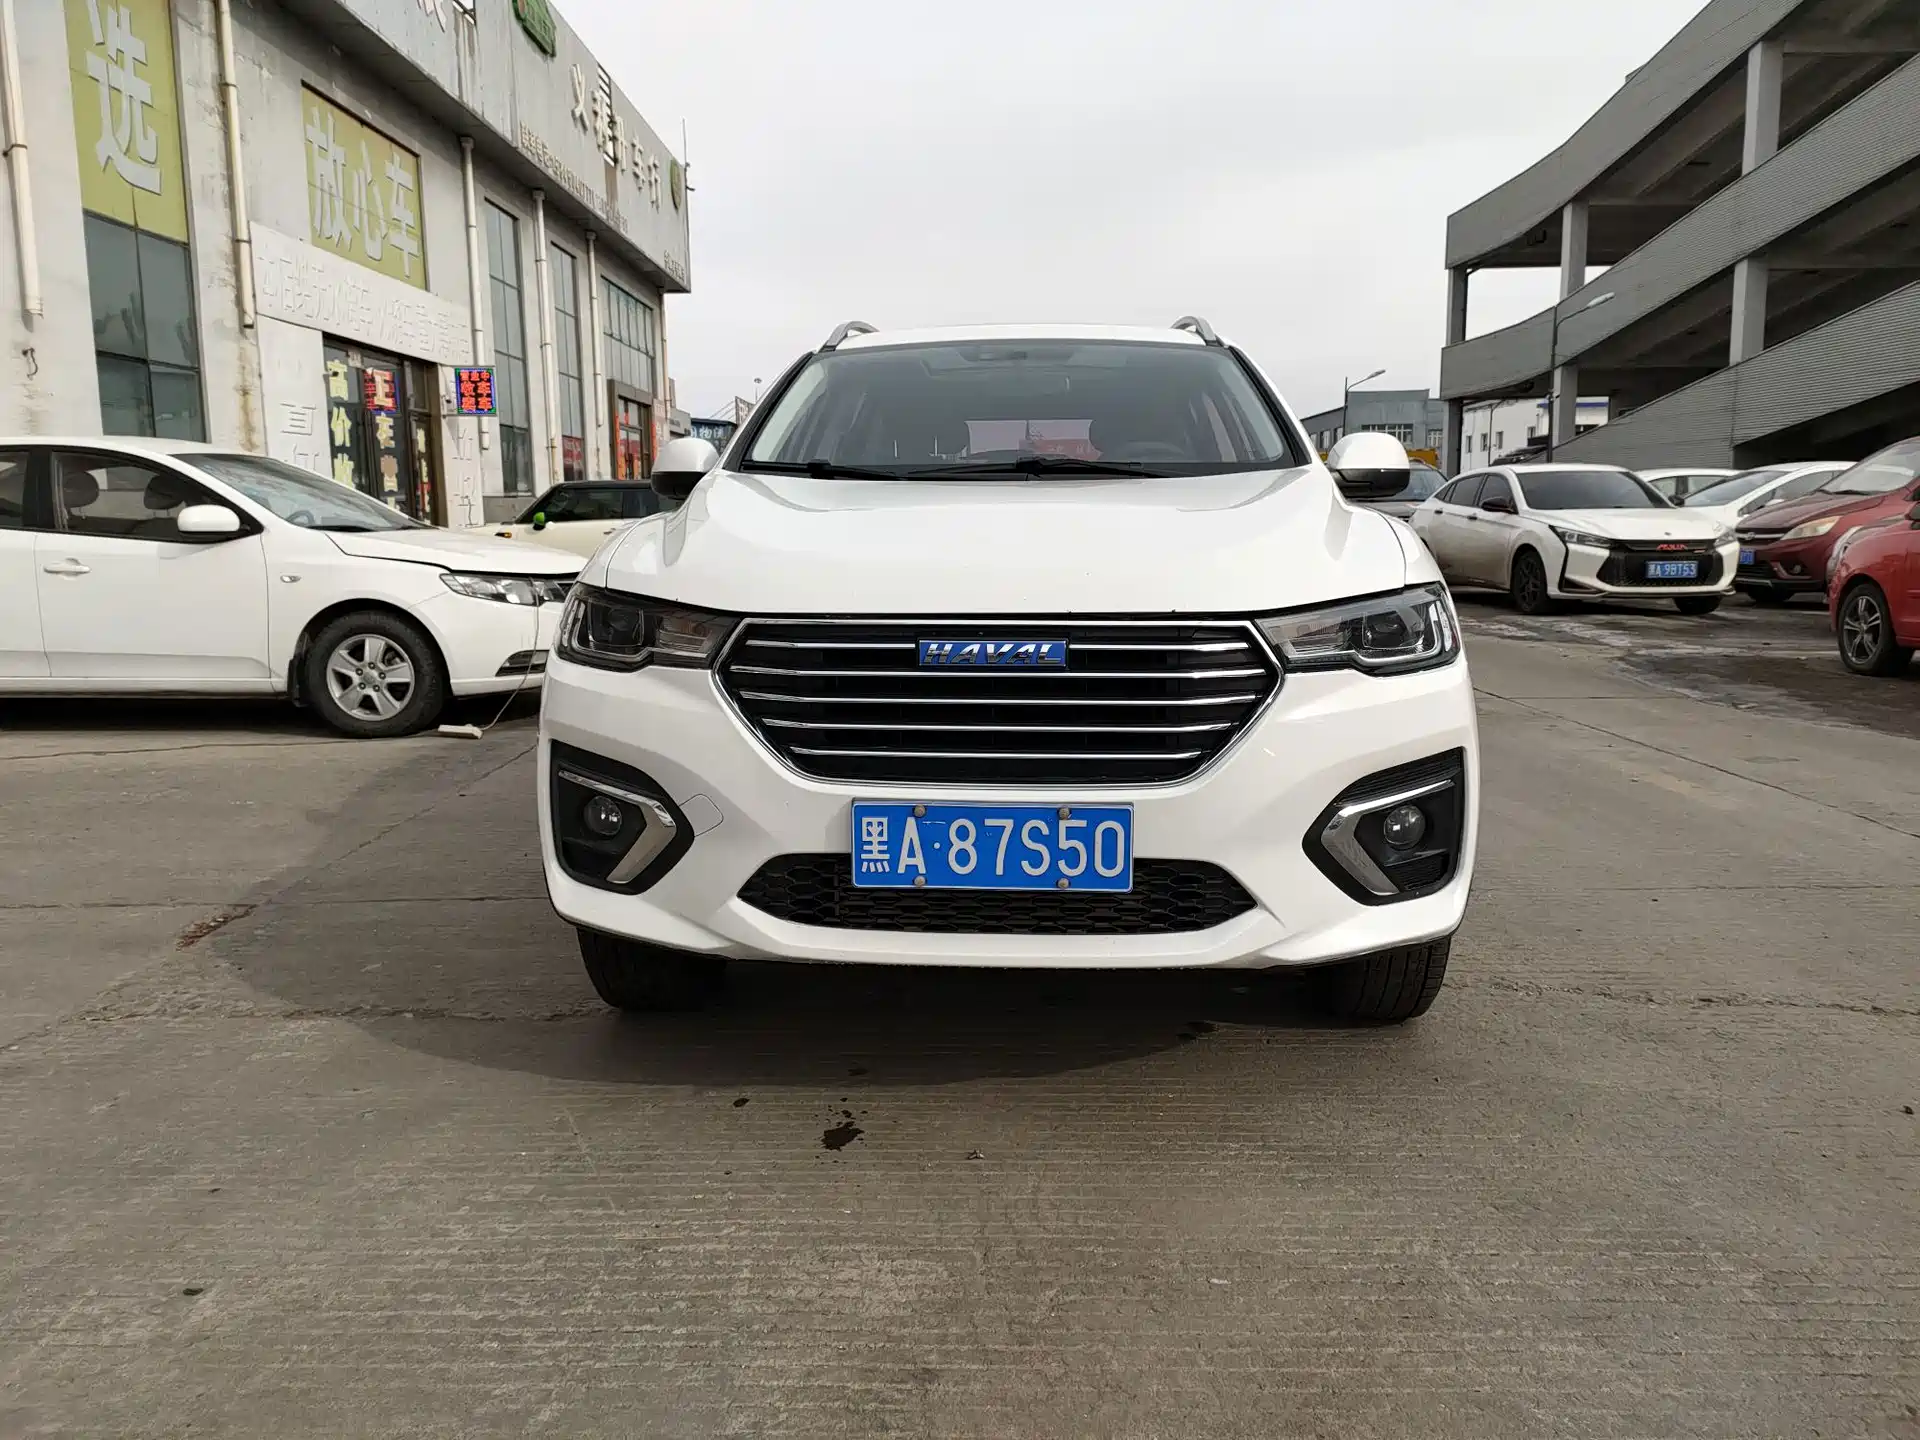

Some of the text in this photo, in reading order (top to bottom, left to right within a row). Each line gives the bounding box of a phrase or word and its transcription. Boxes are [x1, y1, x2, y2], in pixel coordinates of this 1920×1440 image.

[85, 0, 163, 196] 选
[305, 105, 422, 279] 放心车
[923, 643, 1062, 664] HAVAL
